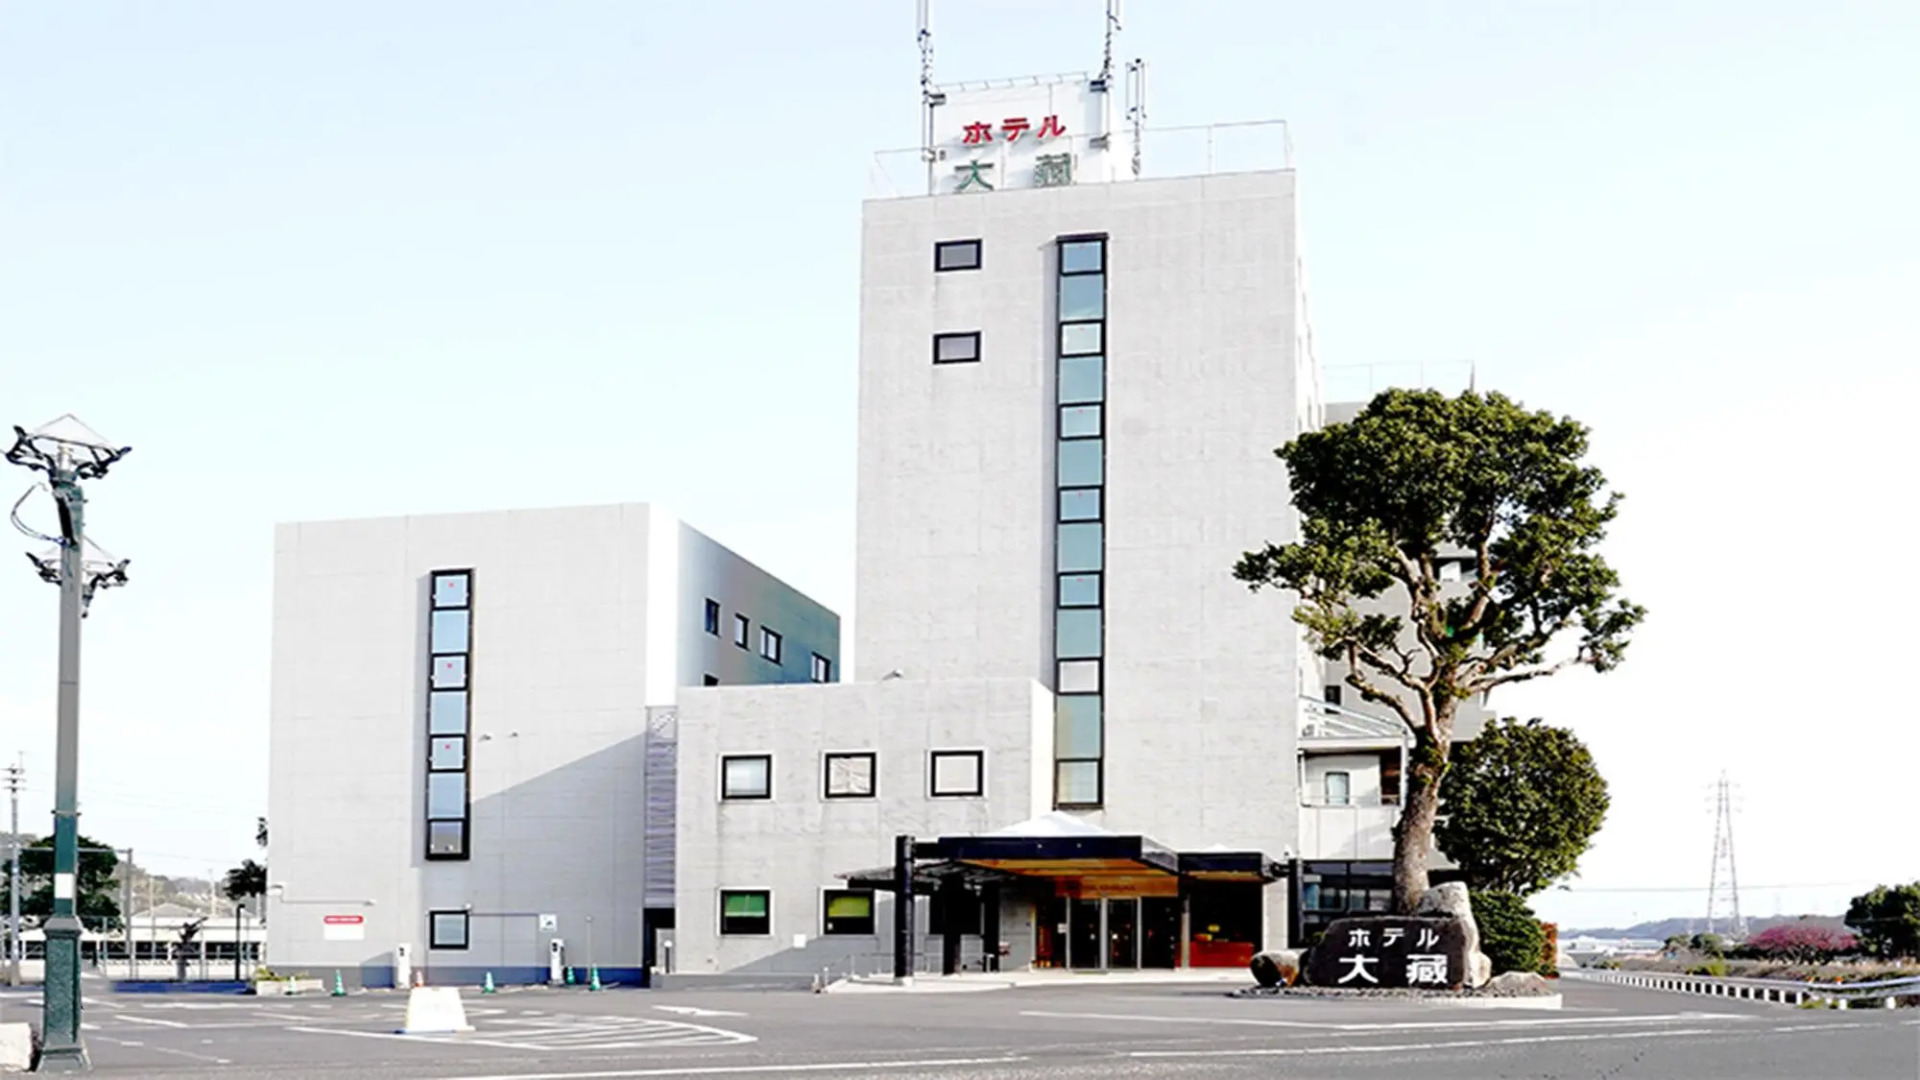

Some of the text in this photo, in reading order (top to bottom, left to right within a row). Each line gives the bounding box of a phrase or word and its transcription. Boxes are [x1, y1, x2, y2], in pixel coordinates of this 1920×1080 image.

[963, 115, 1066, 143] ホテル
[1348, 928, 1440, 947] ホテル
